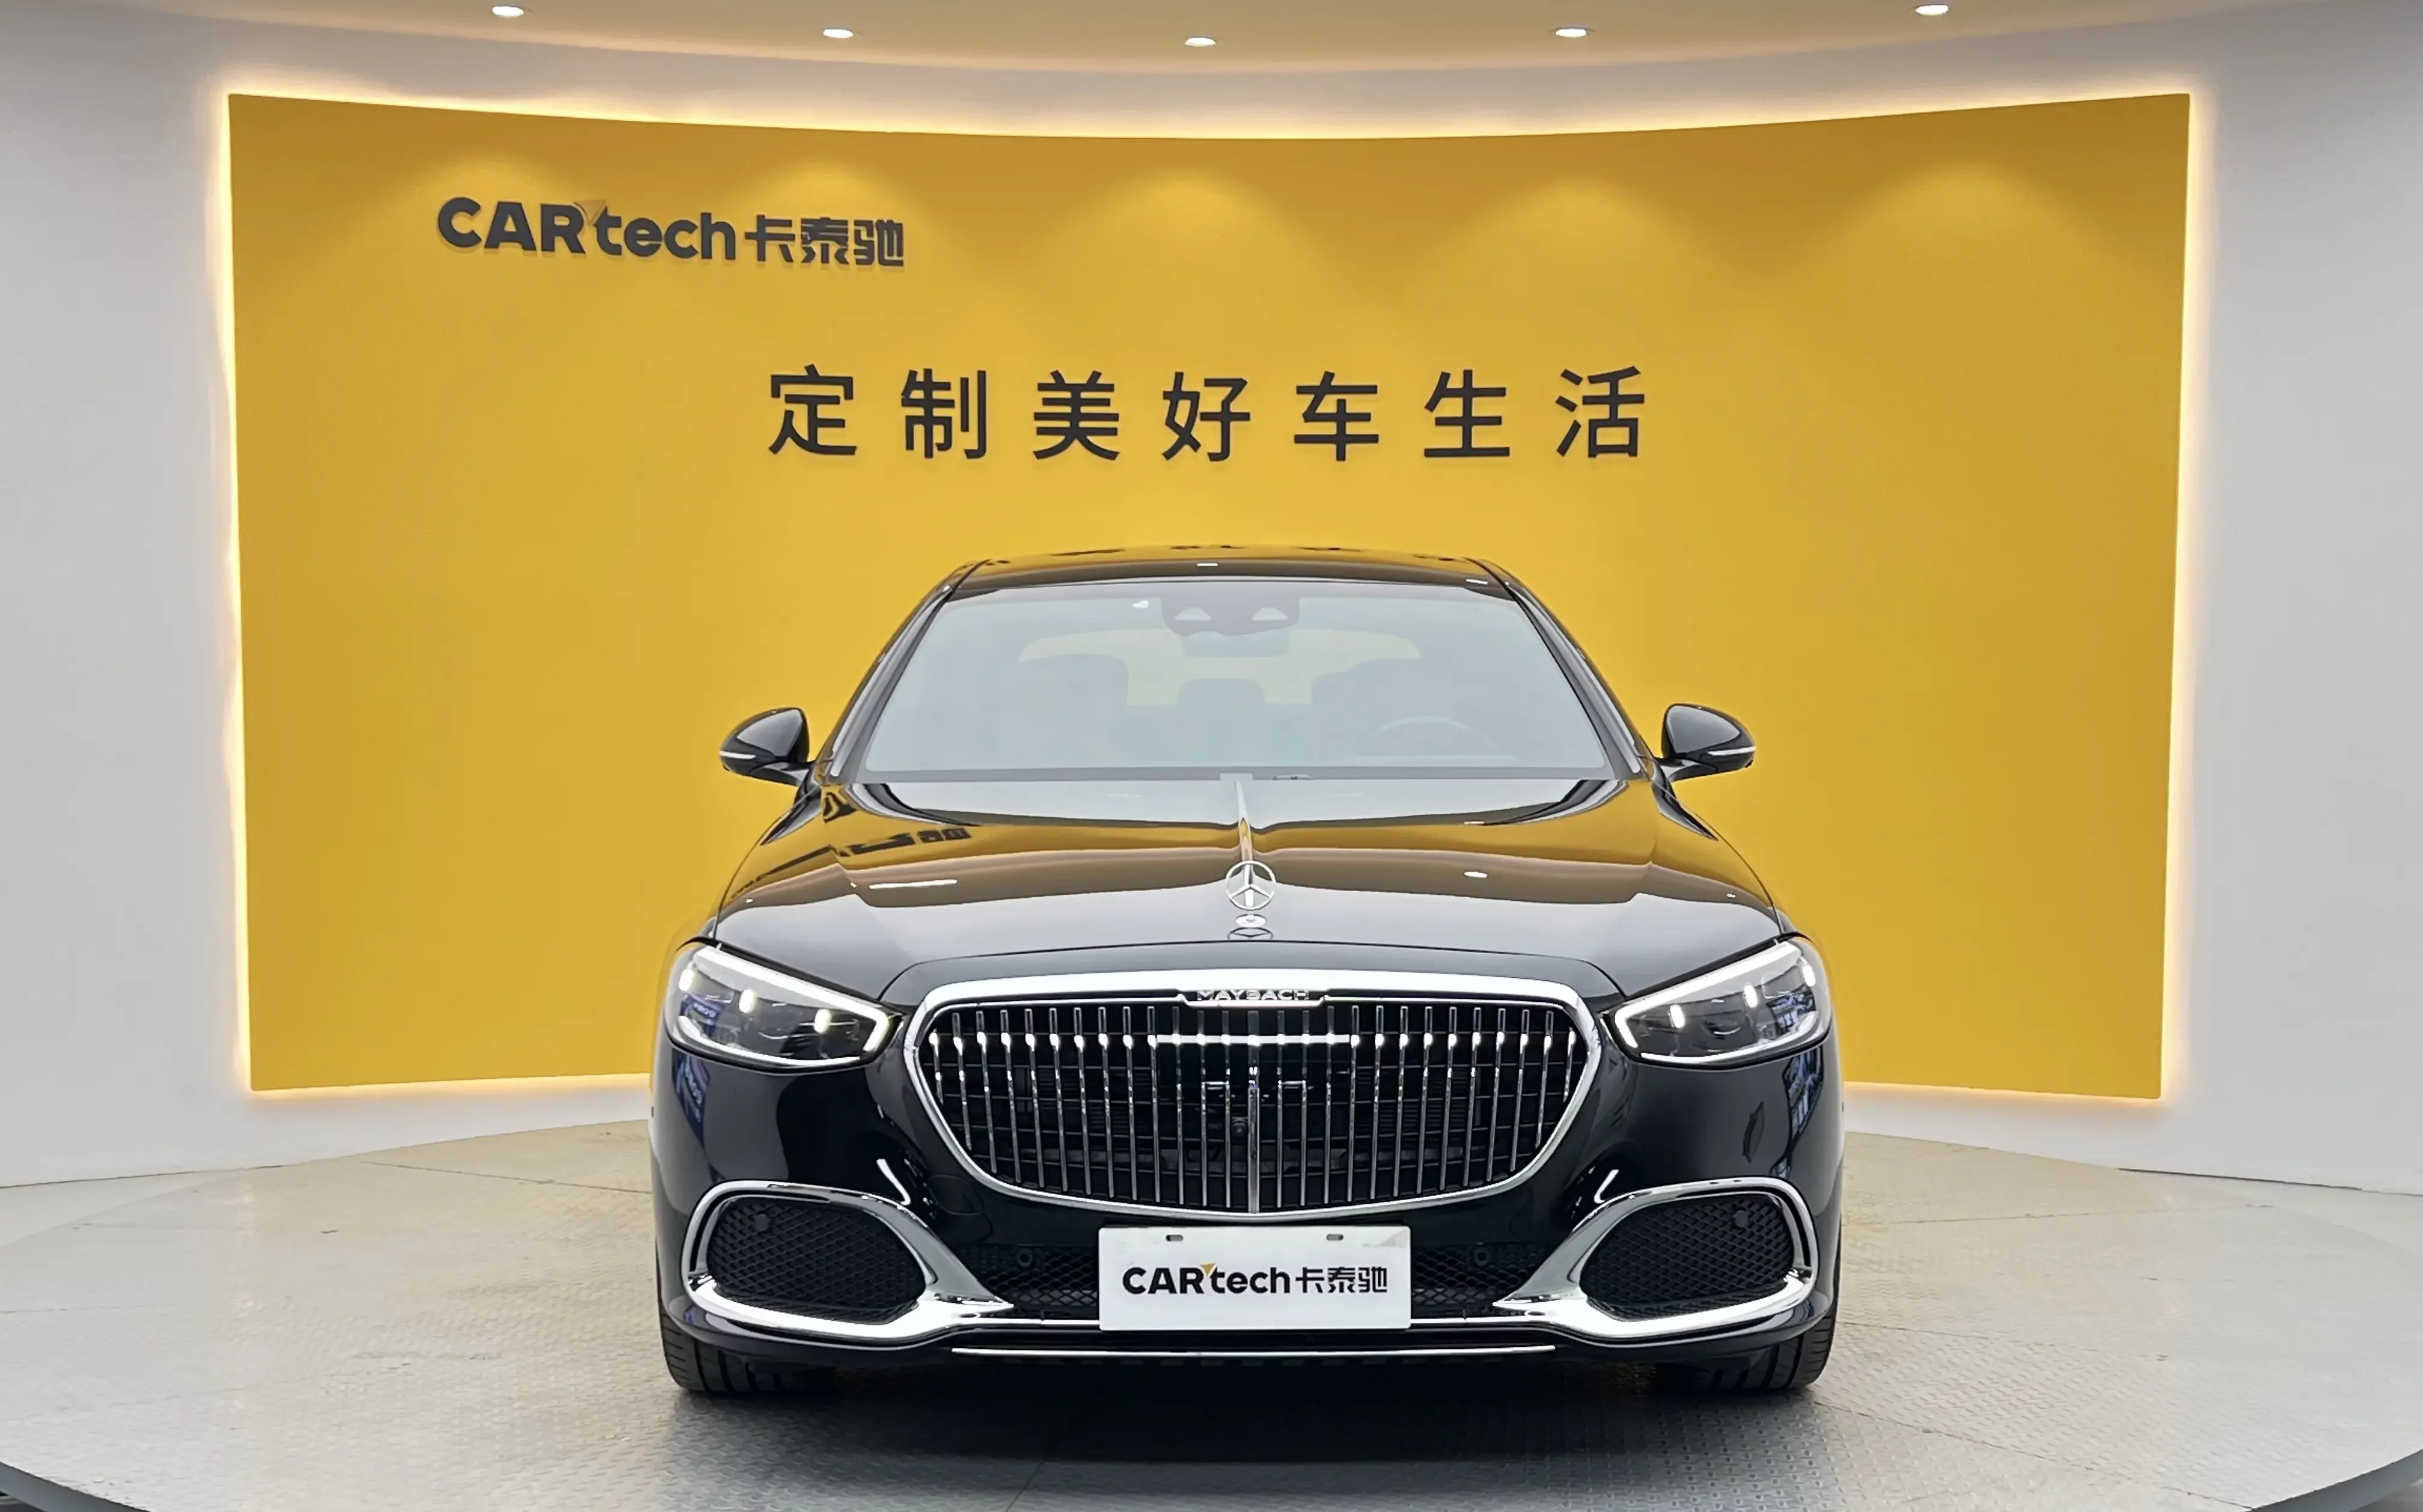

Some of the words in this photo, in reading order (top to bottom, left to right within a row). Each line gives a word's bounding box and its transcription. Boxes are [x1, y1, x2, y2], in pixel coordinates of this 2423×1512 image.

[744, 214, 905, 267] 卡泰驰
[768, 364, 1645, 462] 定制美好车生活
[1197, 990, 1309, 1001] MAYBACH
[1295, 1266, 1387, 1293] 卡泰驰
